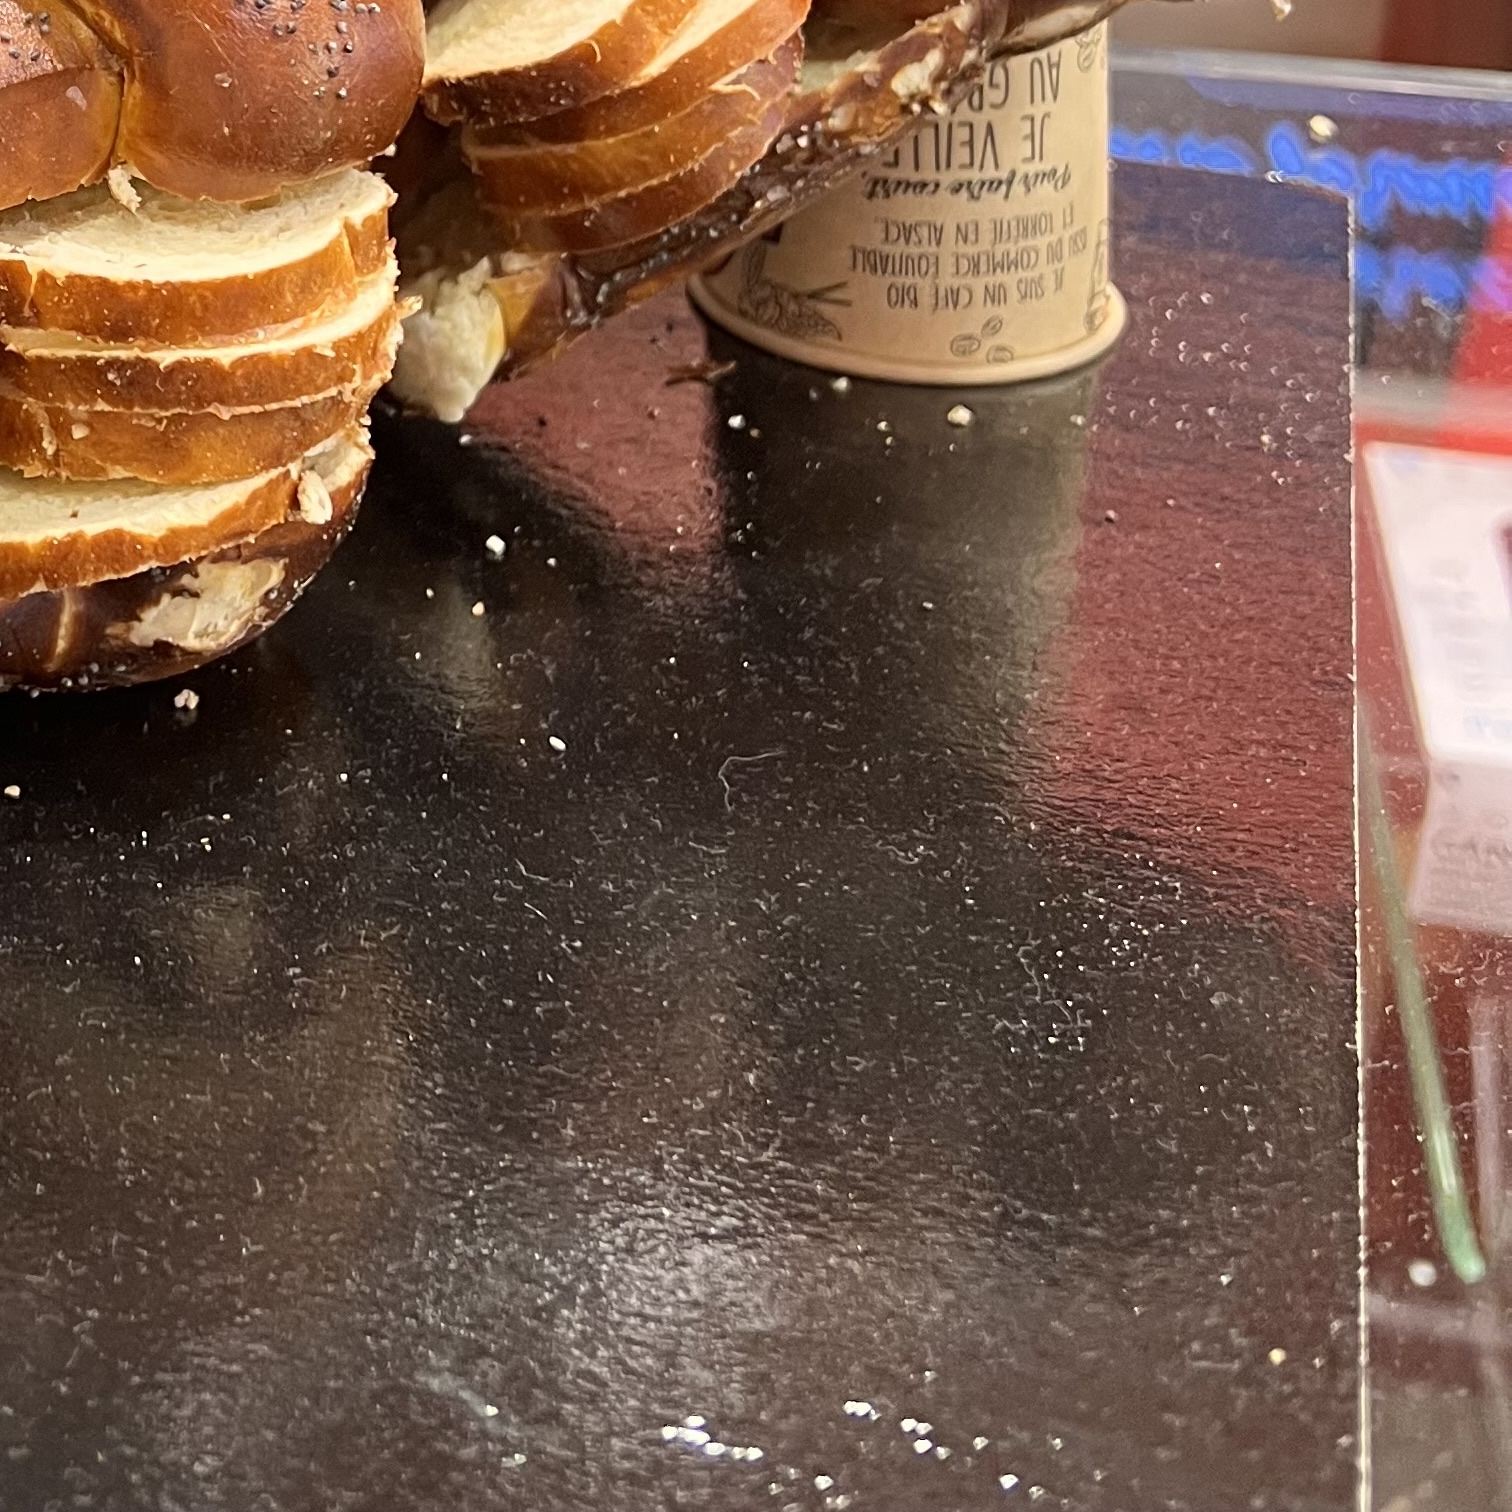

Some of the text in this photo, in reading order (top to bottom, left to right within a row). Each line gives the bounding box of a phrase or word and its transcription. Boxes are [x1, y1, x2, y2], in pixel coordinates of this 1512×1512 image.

[1029, 50, 1061, 105] AU
[1020, 112, 1051, 165] JE
[861, 164, 1071, 202] Pour faire court,
[955, 222, 978, 246] EN
[951, 247, 1039, 278] COMMERCE
[1047, 238, 1063, 266] DU
[1016, 274, 1044, 303] SUIS
[1053, 267, 1064, 293] JE
[887, 282, 918, 310] BIO
[983, 282, 1007, 309] UN
